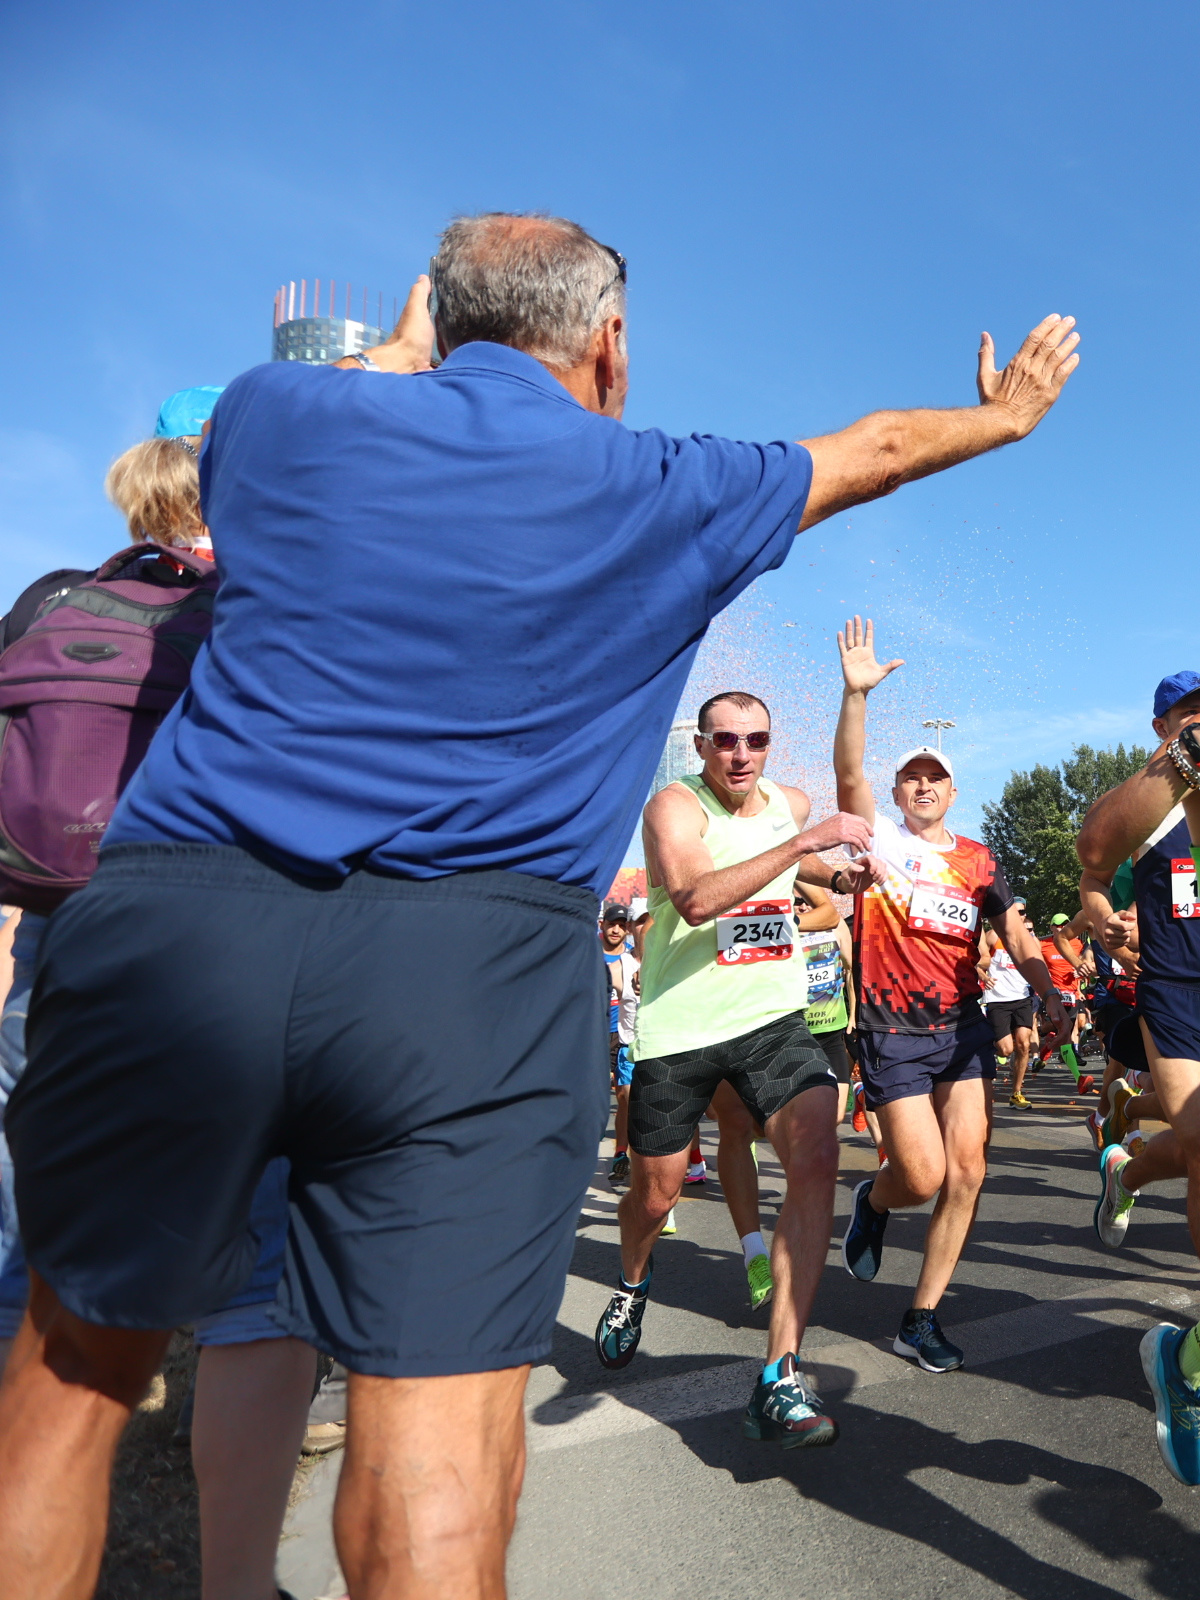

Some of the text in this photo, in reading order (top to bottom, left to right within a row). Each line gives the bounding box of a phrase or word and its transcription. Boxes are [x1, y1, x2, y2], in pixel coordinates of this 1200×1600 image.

[733, 922, 784, 943] 2347
[728, 946, 738, 959] A
[807, 971, 829, 983] 362
